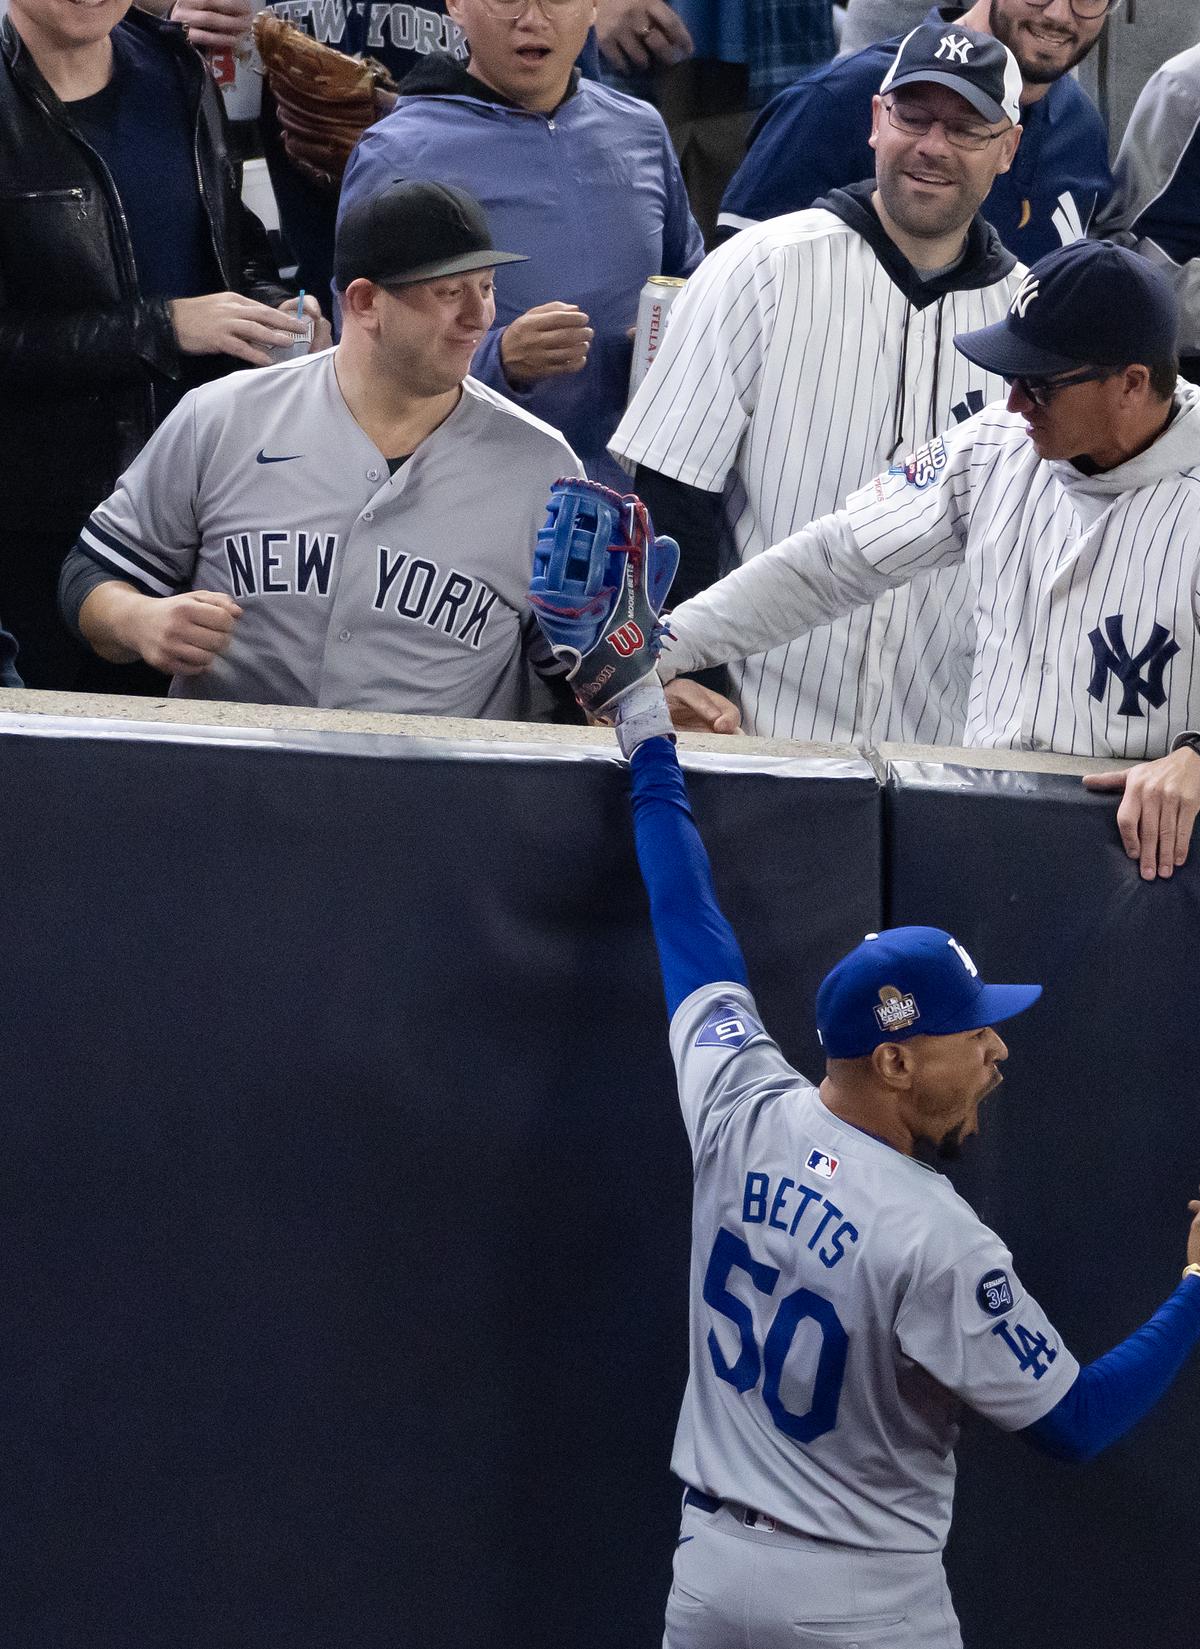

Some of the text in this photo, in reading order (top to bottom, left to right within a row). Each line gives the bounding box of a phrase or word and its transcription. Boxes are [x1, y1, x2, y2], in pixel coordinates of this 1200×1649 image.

[357, 3, 470, 60] YORK
[934, 34, 974, 64] NY
[647, 304, 662, 352] STELLA
[224, 530, 499, 651] NEW YORK
[605, 620, 645, 658] W
[1086, 614, 1181, 718] NY
[877, 999, 914, 1018] WORLD
[881, 1009, 915, 1025] SERIES
[742, 1171, 858, 1268] BETTS
[986, 1283, 1011, 1309] 34
[703, 1227, 848, 1444] 50
[991, 1319, 1057, 1381] LA
